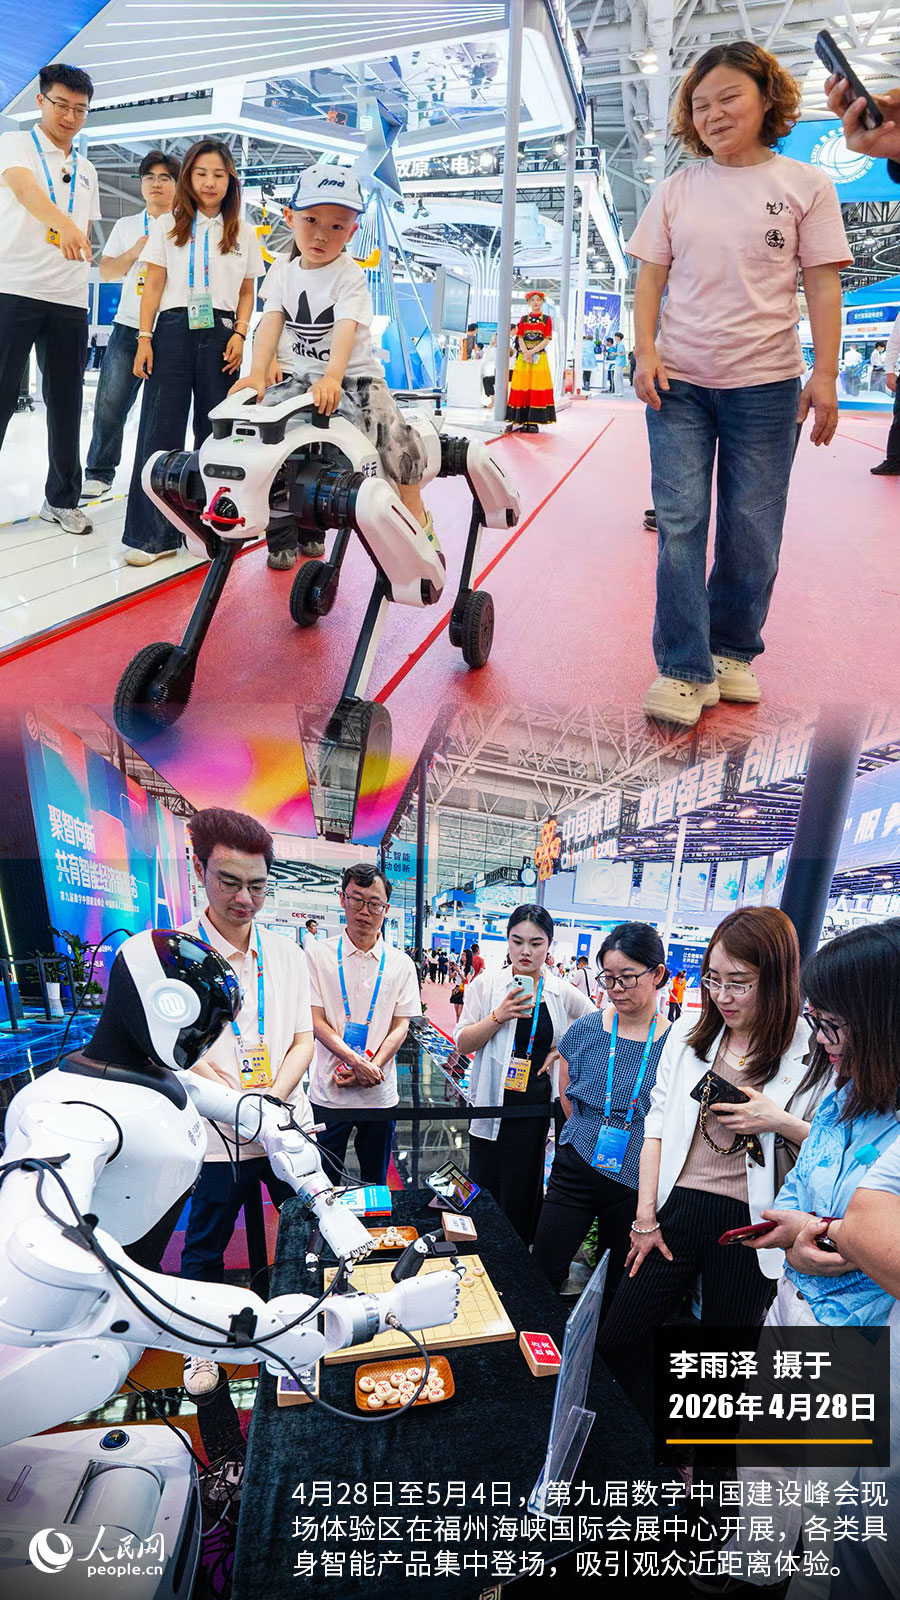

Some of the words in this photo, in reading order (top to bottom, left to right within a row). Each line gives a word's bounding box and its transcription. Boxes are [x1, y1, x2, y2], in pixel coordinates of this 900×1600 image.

[562, 790, 621, 847] 中国联通
[637, 752, 728, 830] 数智强基
[47, 803, 97, 854] 聚智向新
